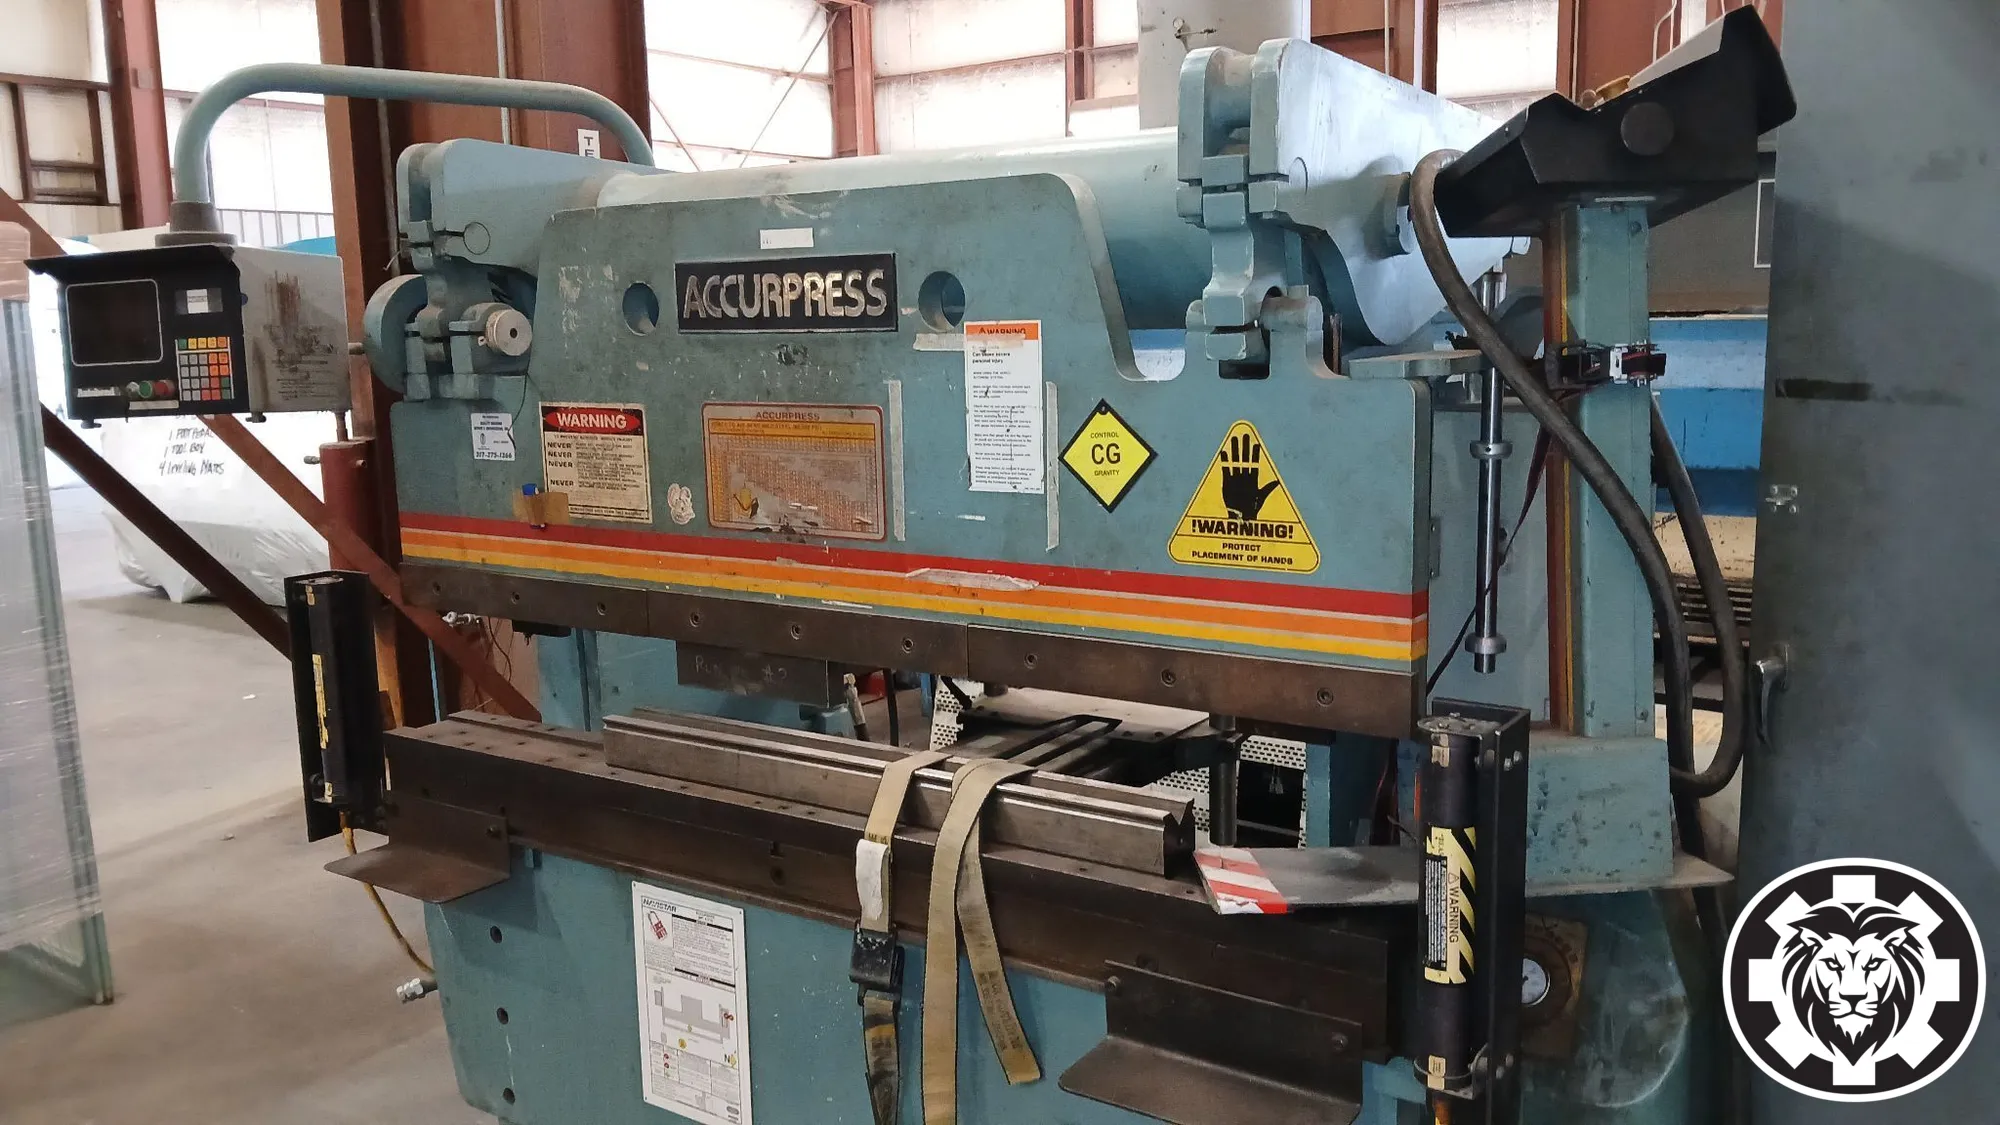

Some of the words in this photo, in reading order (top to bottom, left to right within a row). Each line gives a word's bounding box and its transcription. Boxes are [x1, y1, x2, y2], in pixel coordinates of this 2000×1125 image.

[683, 267, 888, 318] ACCURPRESS
[556, 412, 628, 429] WARNING
[755, 411, 821, 421] ACCURPRESS
[1090, 431, 1120, 439] CONTROL
[547, 441, 572, 449] NEVER
[547, 450, 572, 458] NEVER
[1091, 442, 1121, 465] CG
[159, 460, 166, 476] 4
[548, 460, 573, 468] NEVER
[550, 479, 574, 487] NEVER
[1222, 542, 1261, 552] PROTECT
[1192, 550, 1244, 561] PLACEMENT
[1246, 554, 1259, 562] OF
[1261, 556, 1293, 565] HANDS
[643, 898, 677, 913] NAVISTAR
[1449, 886, 1459, 943] WARNING
